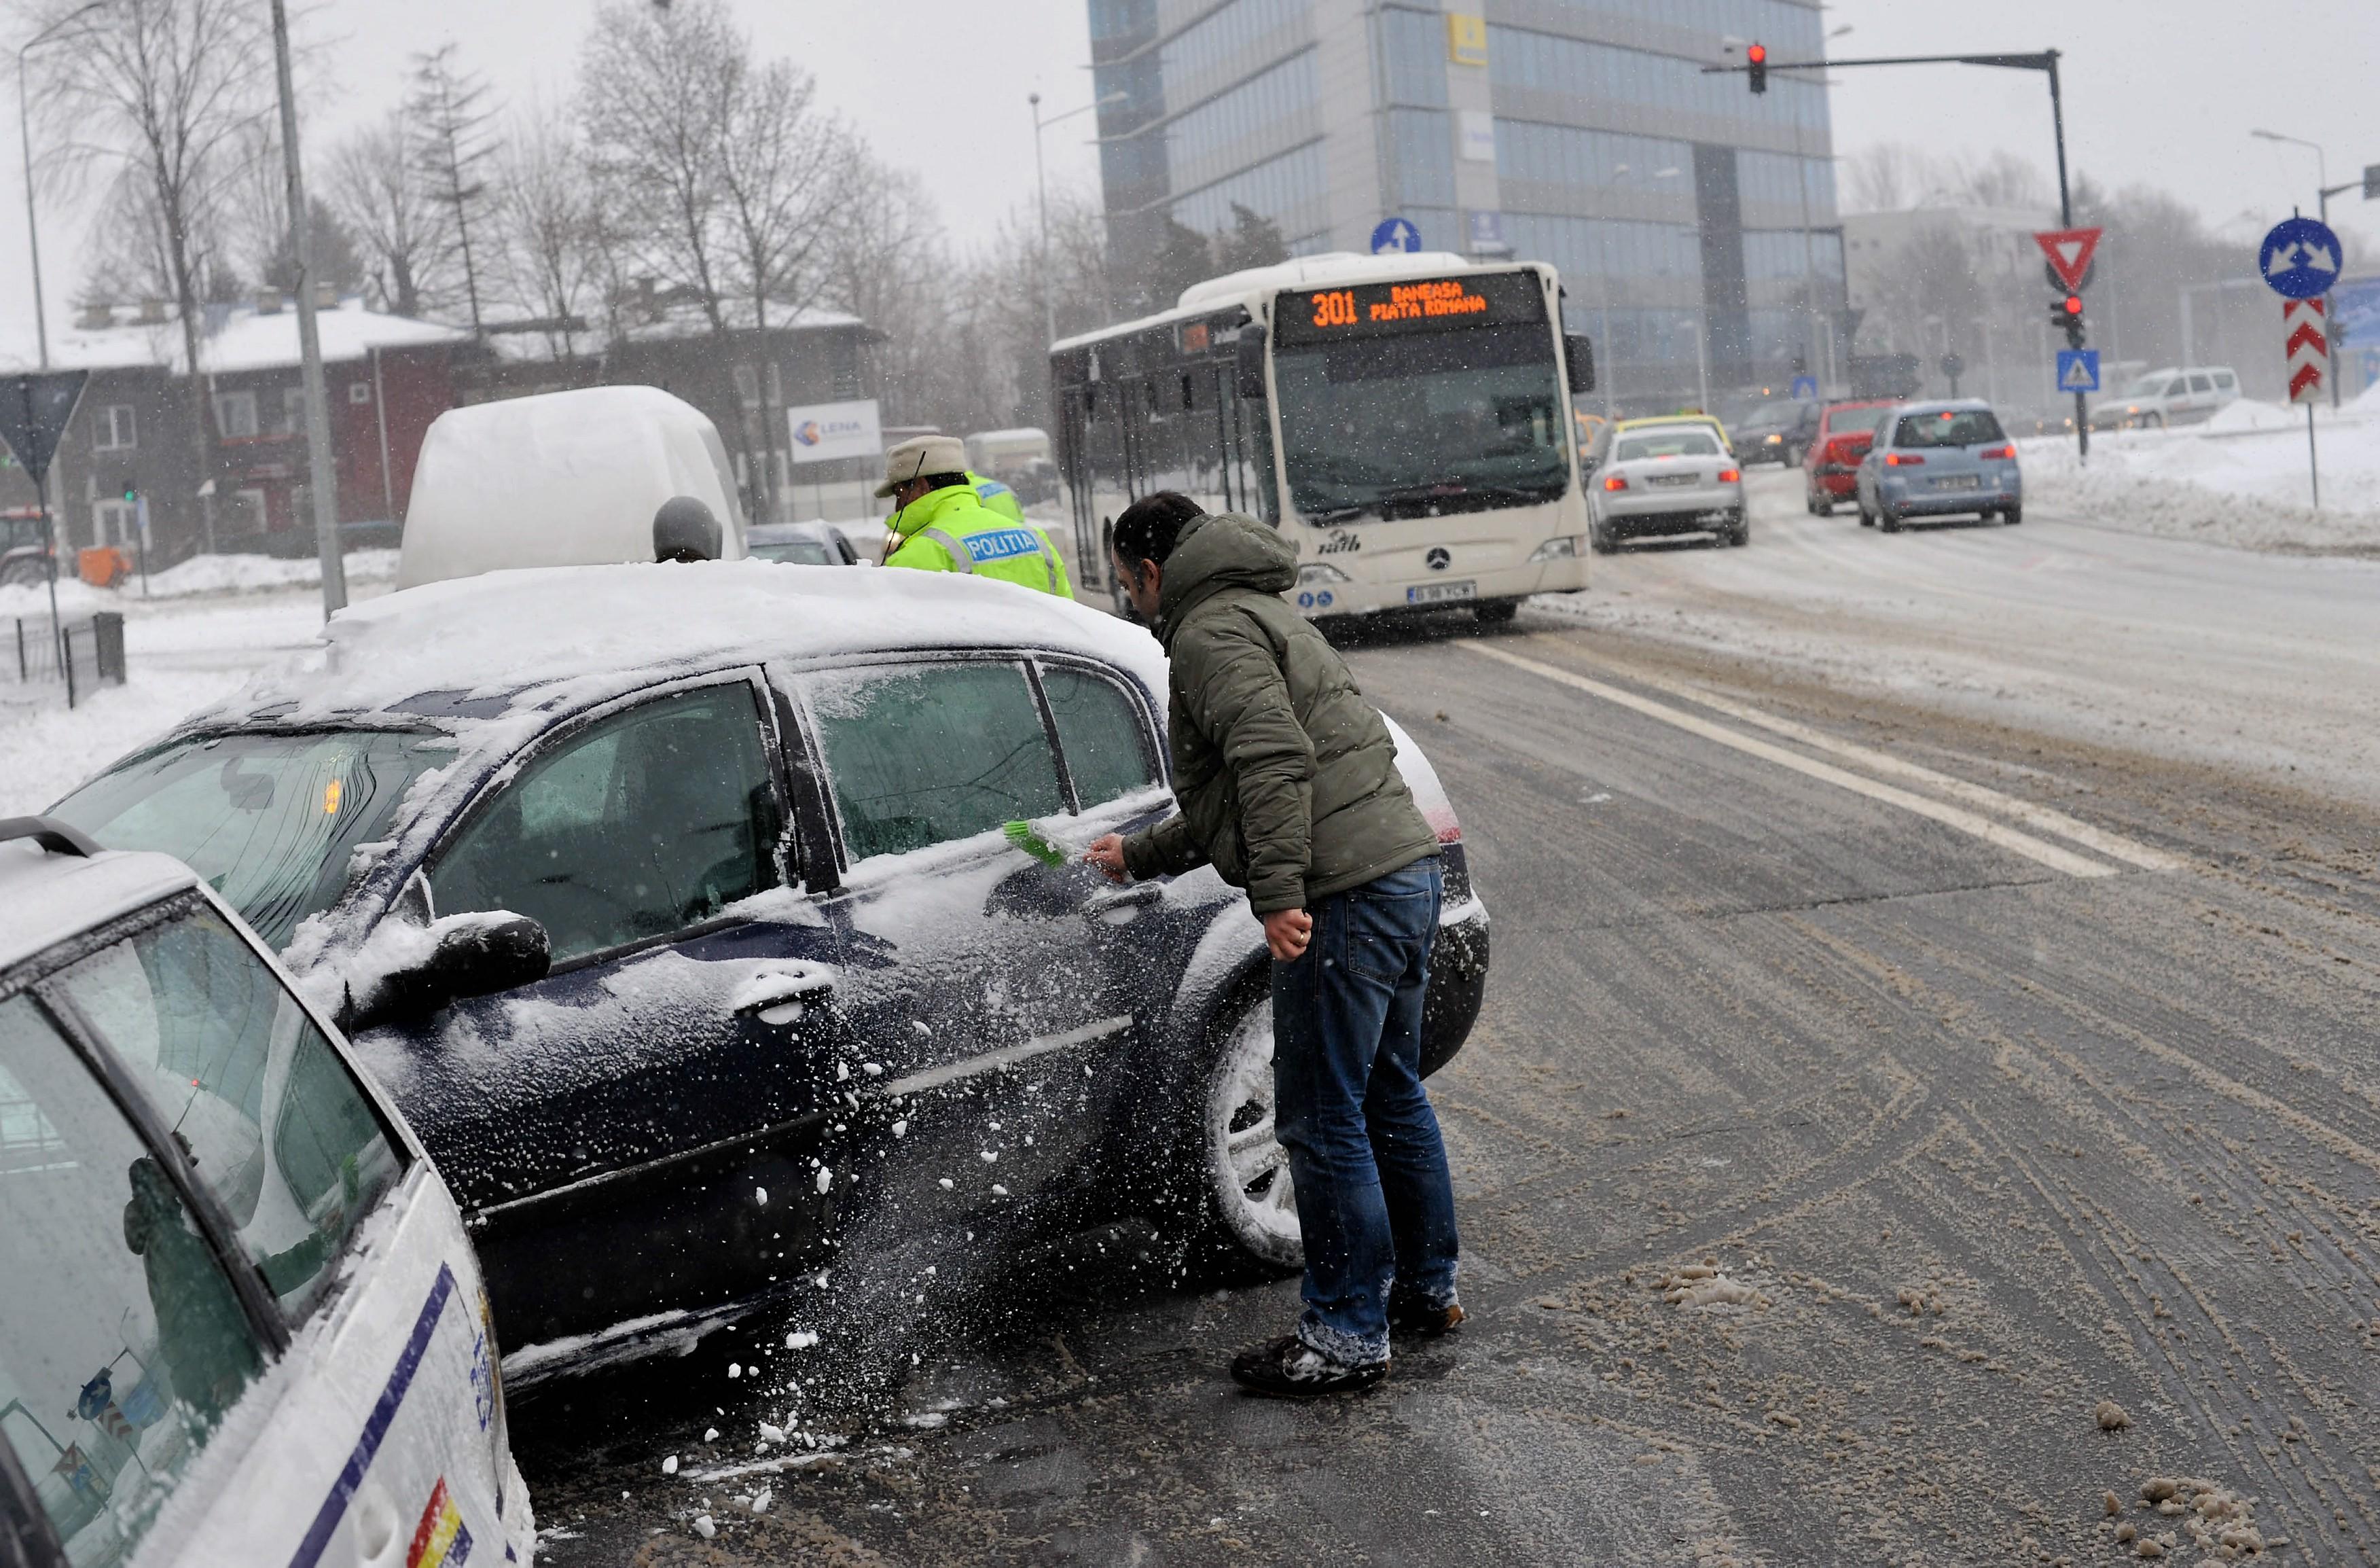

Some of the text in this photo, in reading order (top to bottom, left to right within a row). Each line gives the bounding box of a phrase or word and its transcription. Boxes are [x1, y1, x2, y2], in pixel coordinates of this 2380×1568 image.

[1391, 281, 1463, 303] BANEASA
[1312, 291, 1358, 327] 301
[1369, 294, 1488, 321] PIATA ROMANA
[966, 533, 1037, 558] POLITIA
